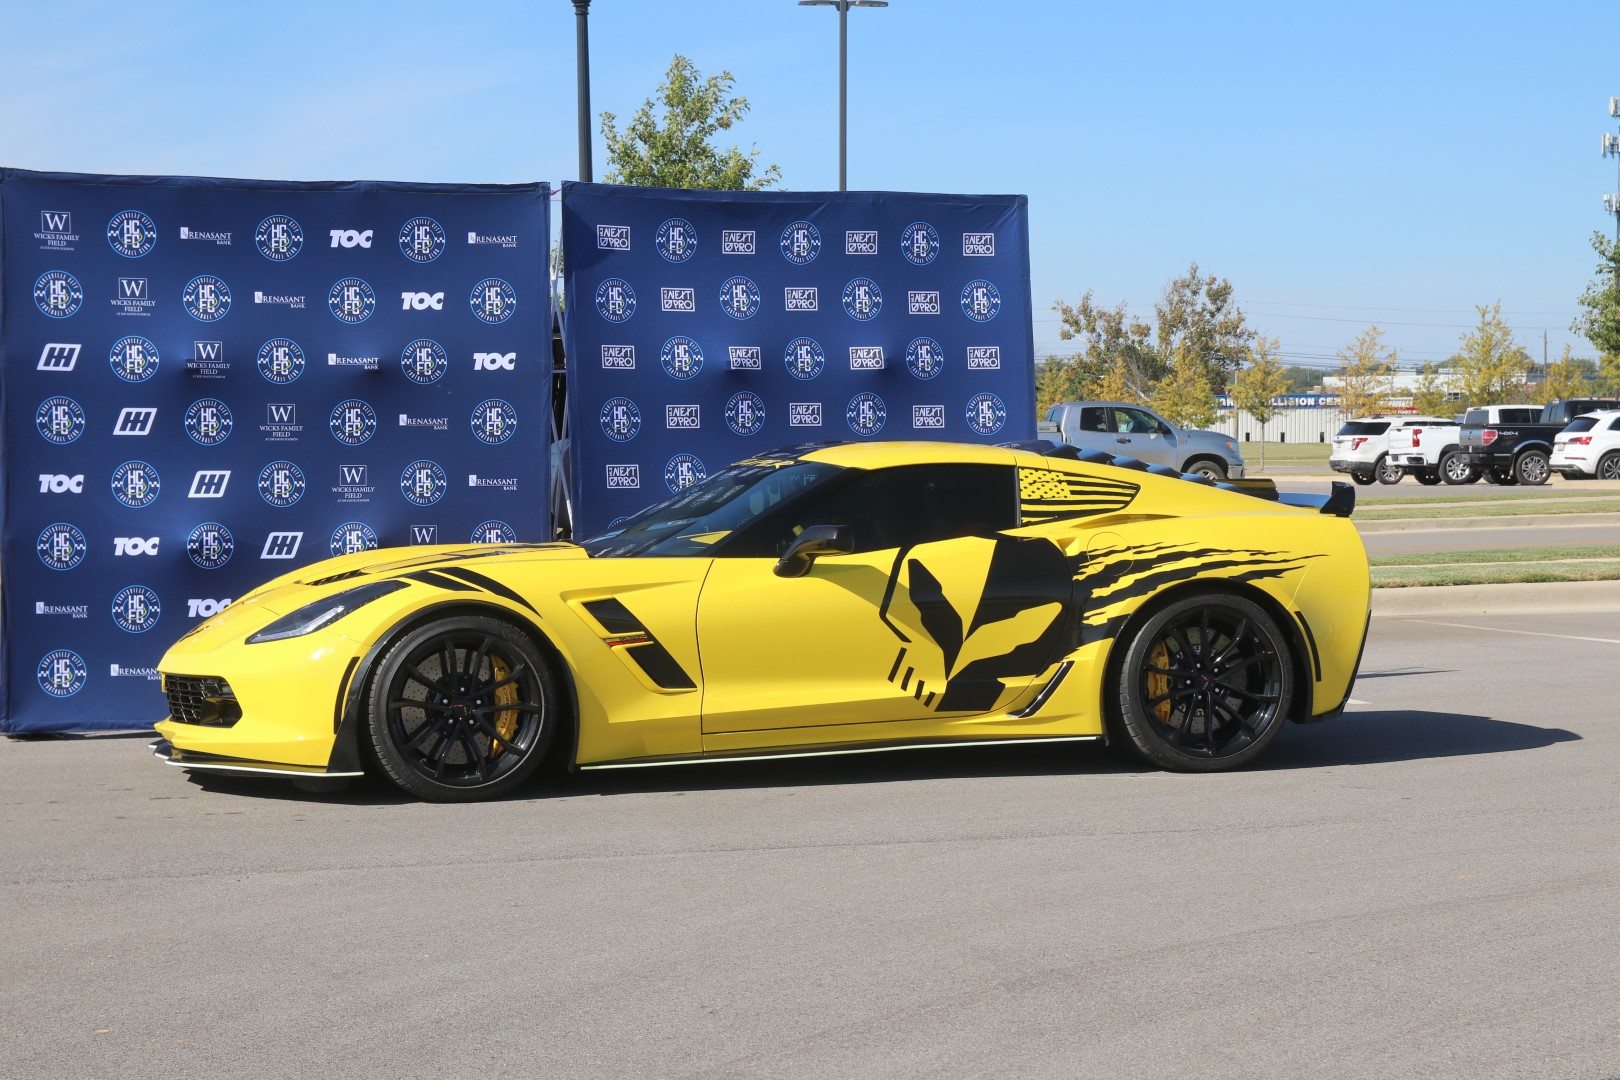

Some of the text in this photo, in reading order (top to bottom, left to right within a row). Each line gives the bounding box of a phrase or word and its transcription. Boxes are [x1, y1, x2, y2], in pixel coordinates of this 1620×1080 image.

[45, 213, 67, 230] W
[124, 220, 140, 234] HC
[272, 224, 287, 238] HC
[414, 226, 429, 240] HC
[604, 229, 627, 238] NEXT
[670, 227, 683, 240] HC
[794, 230, 807, 243] HC
[914, 231, 926, 244] HC
[124, 234, 140, 248] FC
[330, 230, 373, 248] TOC
[609, 238, 627, 248] PRO
[729, 234, 752, 242] NEXT
[852, 234, 874, 242] NEXT
[969, 236, 991, 244] NEXT
[272, 238, 287, 252] FC
[415, 240, 430, 253] FC
[670, 240, 683, 254] FC
[734, 243, 753, 251] PRO
[794, 243, 807, 256] FC
[857, 243, 875, 251] PRO
[914, 244, 926, 256] FC
[974, 245, 992, 254] PRO
[50, 280, 66, 294] HC
[122, 280, 143, 296] W
[199, 285, 215, 299] HC
[609, 287, 622, 300] HC
[733, 285, 746, 298] HC
[344, 287, 359, 301] HC
[485, 288, 500, 301] HC
[668, 291, 692, 300] NEXT
[792, 291, 815, 299] NEXT
[915, 294, 937, 303] NEXT
[974, 288, 987, 301] HC
[50, 294, 66, 308] FC
[200, 299, 215, 312] FC
[345, 301, 360, 314] FC
[402, 292, 444, 310] TOC
[486, 301, 501, 314] FC
[609, 300, 622, 314] FC
[673, 300, 692, 309] PRO
[733, 298, 746, 311] FC
[797, 300, 815, 308] PRO
[919, 303, 937, 312] PRO
[974, 301, 987, 313] FC
[126, 345, 142, 359] HC
[198, 343, 219, 360] W
[274, 348, 288, 361] HC
[417, 348, 431, 361] HC
[608, 348, 632, 357] NEXT
[675, 345, 689, 358] HC
[735, 350, 758, 358] NEXT
[856, 350, 881, 358] NEXT
[918, 346, 930, 358] HC
[974, 350, 997, 358] NEXT
[127, 359, 143, 373] FC
[274, 361, 289, 374] FC
[417, 361, 432, 375] FC
[474, 353, 516, 370] TOC
[613, 358, 632, 366] PRO
[675, 358, 689, 370] FC
[740, 359, 759, 367] PRO
[861, 359, 881, 367] PRO
[918, 358, 930, 370] FC
[979, 358, 997, 367] PRO
[53, 406, 68, 420] HC
[271, 406, 292, 422] W
[614, 406, 627, 420] HC
[673, 408, 697, 417] NEXT
[739, 401, 752, 414] HC
[796, 406, 818, 414] NEXT
[860, 401, 873, 414] HC
[919, 408, 942, 417] NEXT
[979, 401, 992, 414] HC
[201, 408, 216, 422] HC
[486, 408, 501, 421] HC
[739, 414, 752, 426] FC
[801, 415, 819, 423] PRO
[860, 414, 873, 427] FC
[979, 414, 992, 426] FC
[53, 420, 68, 434] FC
[486, 421, 501, 435] FC
[614, 420, 627, 432] FC
[678, 417, 697, 426] PRO
[924, 417, 942, 426] PRO
[201, 422, 217, 436] FC
[128, 470, 144, 484] HC
[273, 470, 289, 484] HC
[343, 466, 364, 483] W
[415, 470, 431, 483] HC
[613, 468, 636, 476] NEXT
[39, 474, 84, 493] TOC
[618, 477, 637, 486] PRO
[128, 484, 144, 498] FC
[274, 484, 289, 497] FC
[416, 483, 431, 496] FC
[54, 533, 70, 547] HC
[346, 531, 361, 544] HC
[414, 528, 433, 543] W
[486, 530, 500, 543] HC
[114, 537, 159, 556] TOC
[54, 547, 70, 560] FC
[128, 595, 144, 609] HC
[128, 609, 144, 623] FC
[54, 659, 70, 673] HC
[54, 673, 70, 687] FC
